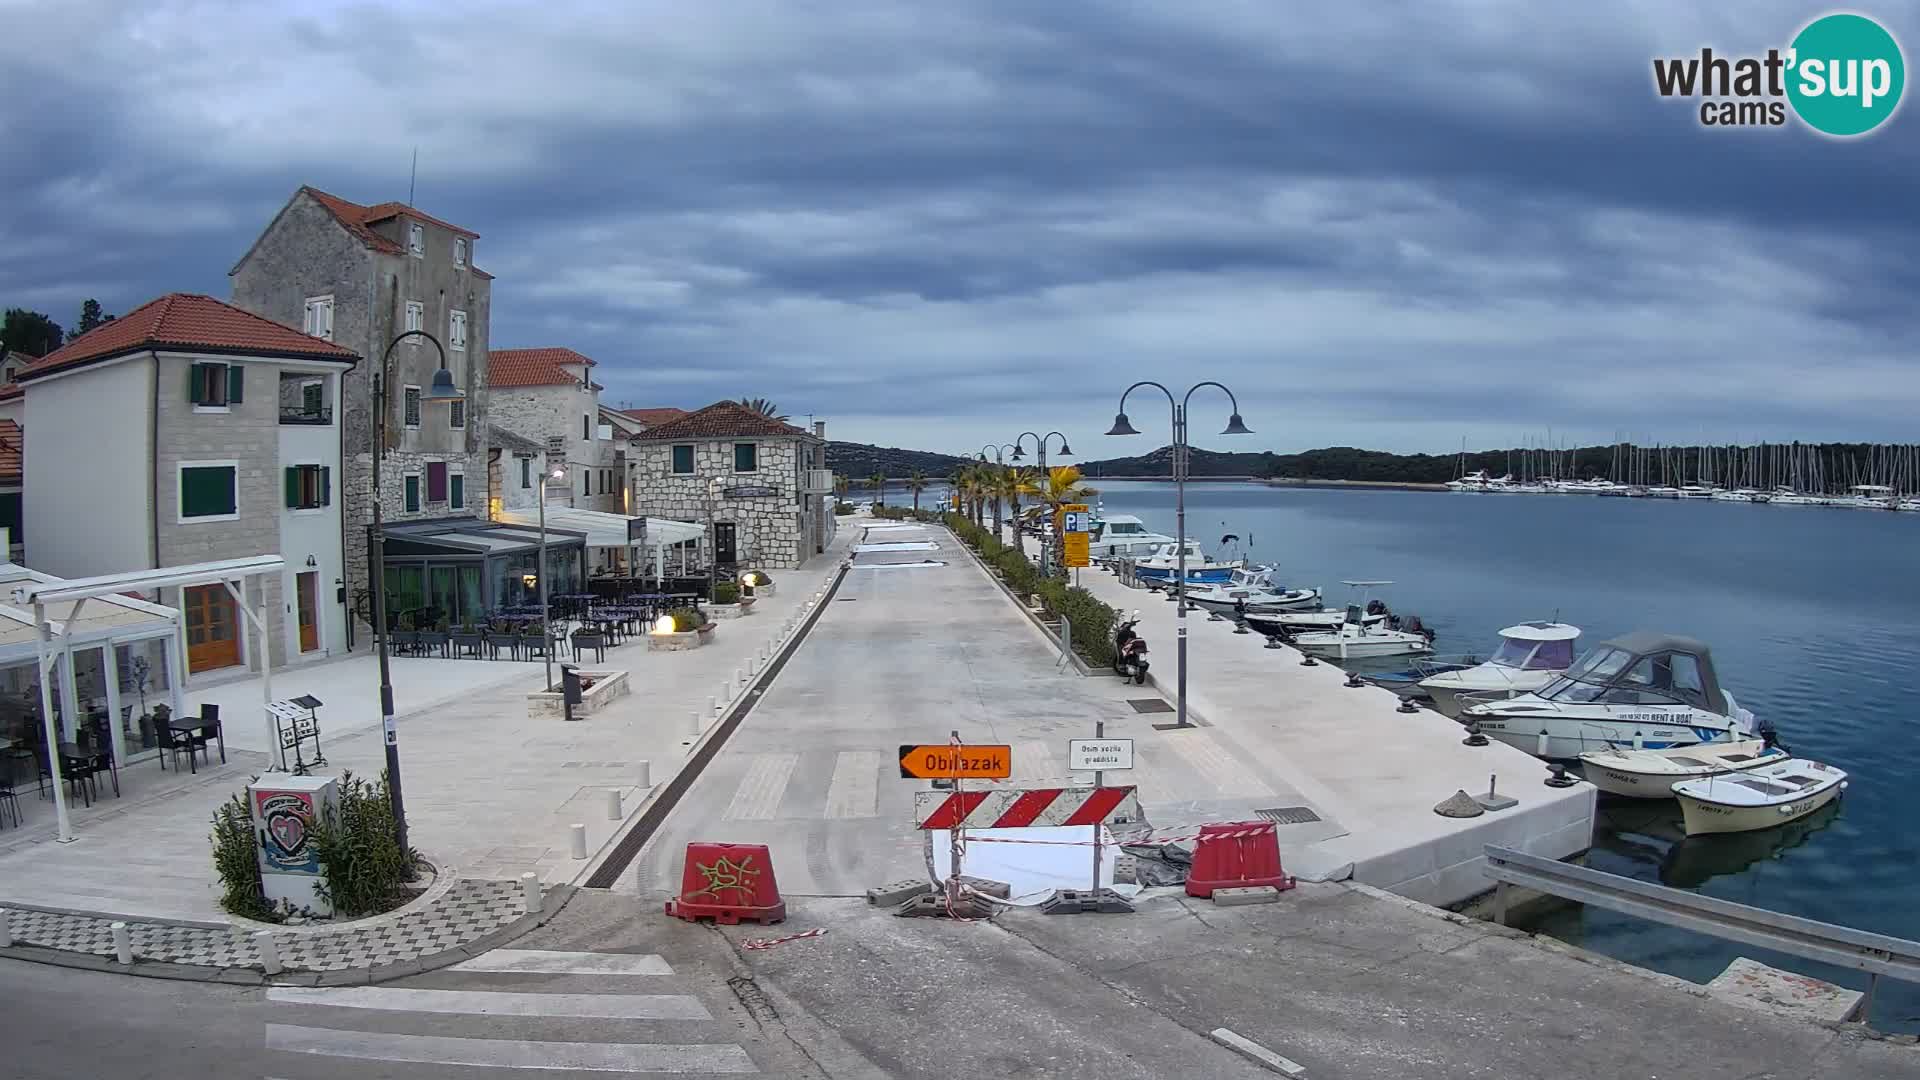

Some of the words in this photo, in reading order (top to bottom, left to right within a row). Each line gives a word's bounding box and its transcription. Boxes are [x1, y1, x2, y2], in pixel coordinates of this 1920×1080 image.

[1066, 514, 1076, 530] P
[1651, 713, 1669, 722] RENT
[1676, 713, 1693, 724] BOAT
[926, 754, 1002, 771] Obilazak
